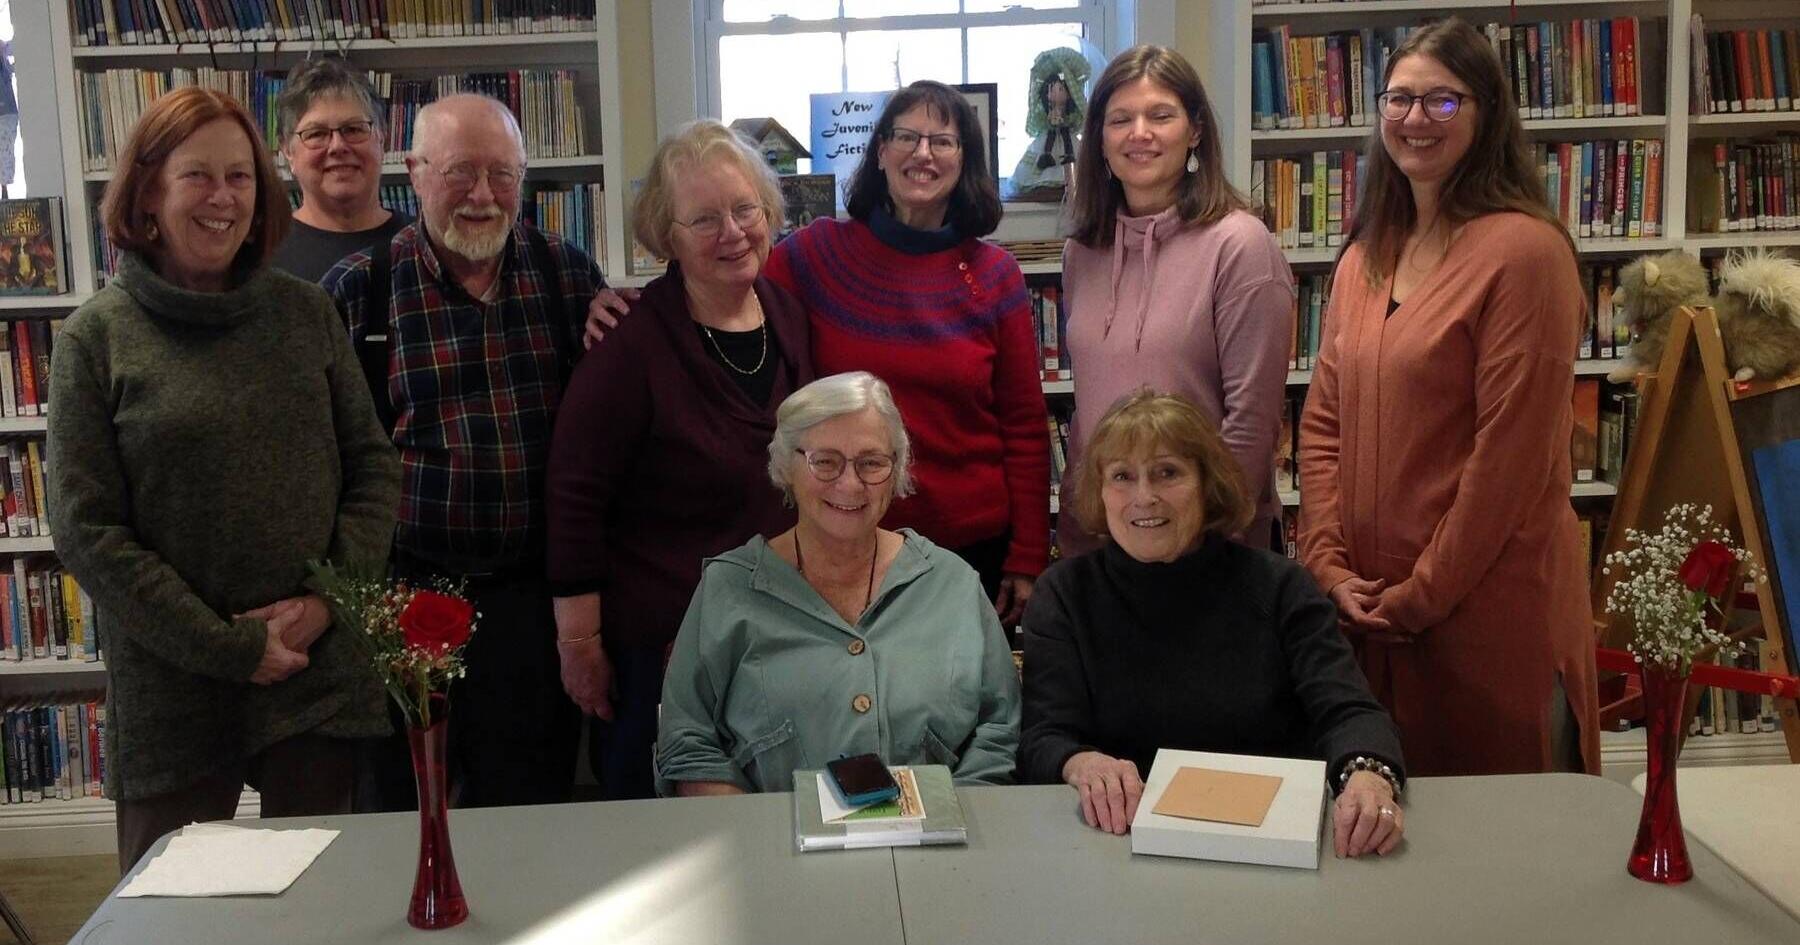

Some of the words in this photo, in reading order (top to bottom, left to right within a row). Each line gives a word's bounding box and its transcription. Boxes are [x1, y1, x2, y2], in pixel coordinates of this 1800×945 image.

[832, 101, 873, 116] New
[821, 122, 873, 138] Juveni
[826, 143, 866, 159] Ficti
[1616, 166, 1626, 210] PRINCESS
